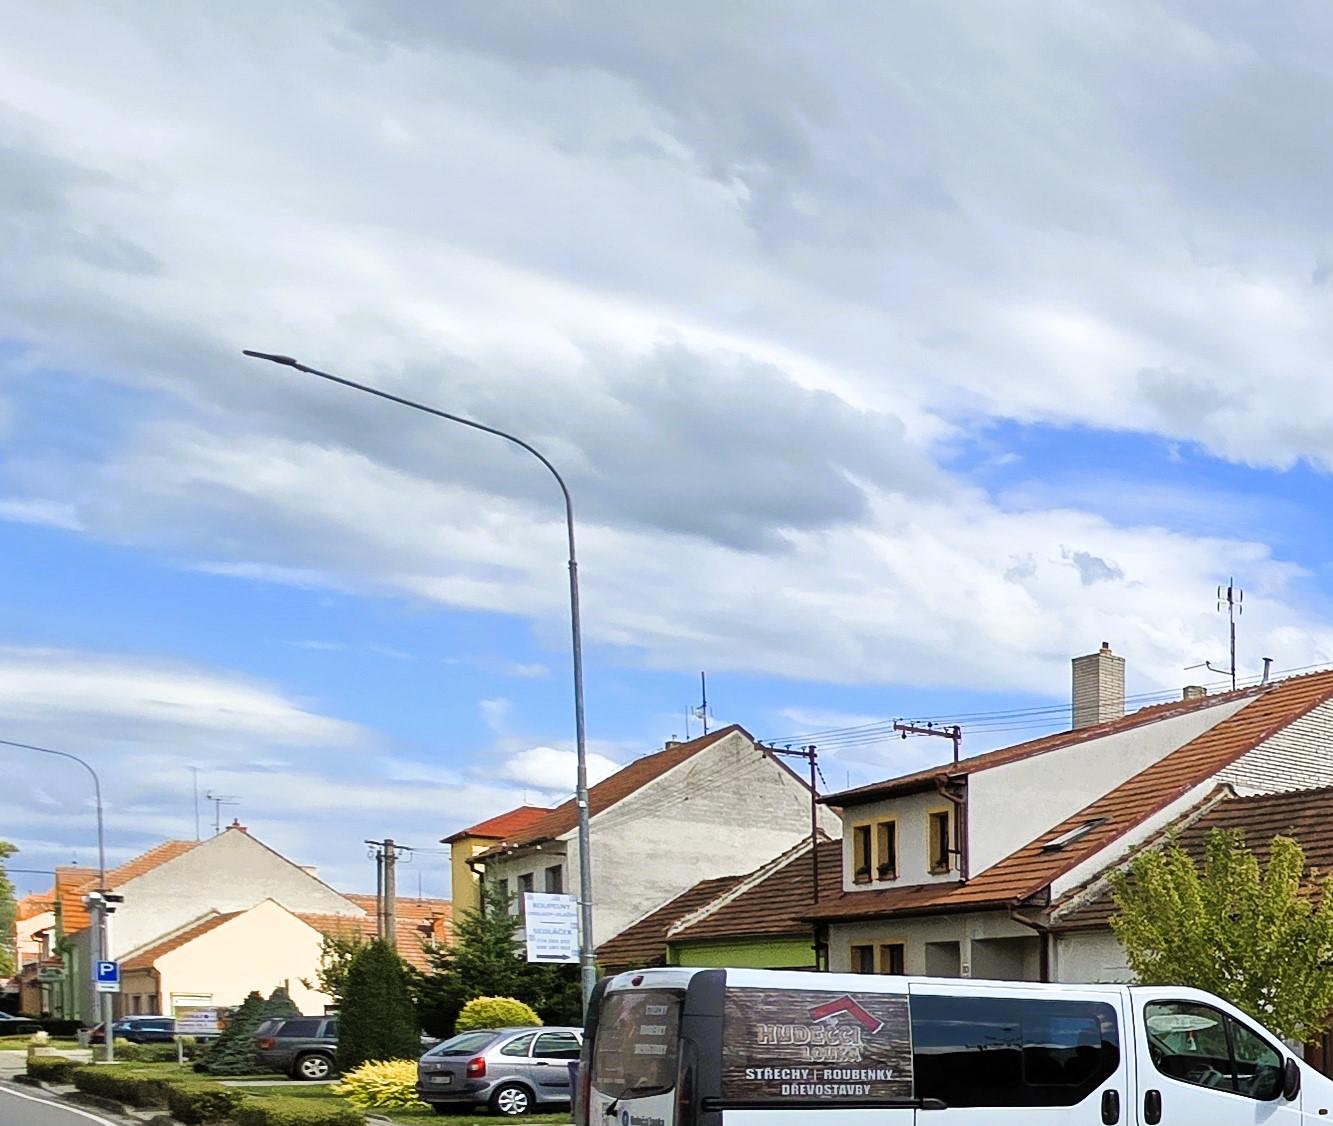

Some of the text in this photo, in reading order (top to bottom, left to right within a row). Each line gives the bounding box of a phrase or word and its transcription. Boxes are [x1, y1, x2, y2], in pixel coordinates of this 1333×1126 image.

[100, 963, 114, 976] P
[745, 1067, 893, 1081] STŘECHY ROUBENKY
[781, 1083, 871, 1096] DŘEVOSTAVBY
